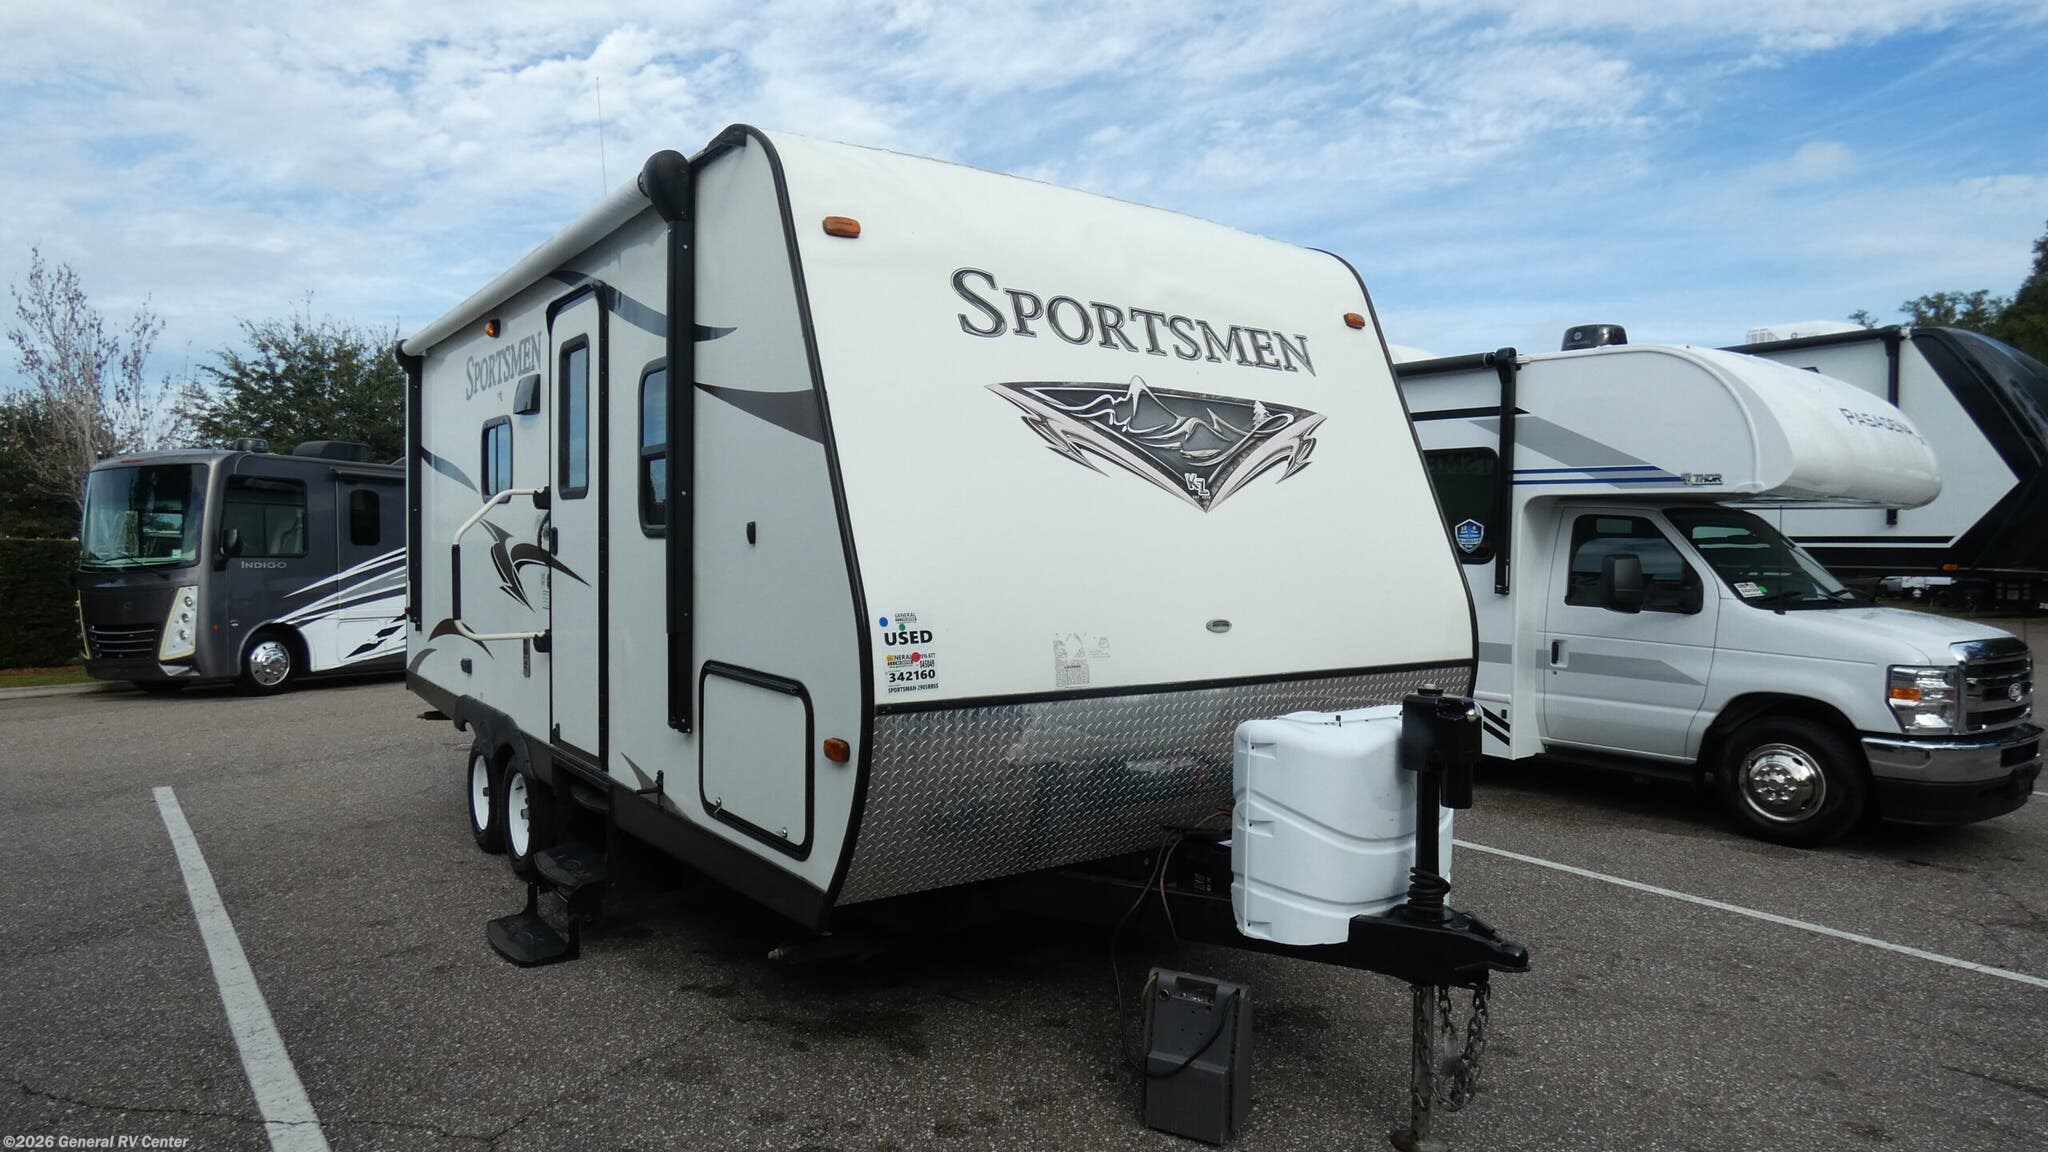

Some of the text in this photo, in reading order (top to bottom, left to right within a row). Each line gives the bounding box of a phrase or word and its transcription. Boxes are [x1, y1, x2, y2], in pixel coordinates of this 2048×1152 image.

[949, 266, 1317, 378] SPORTSMEN
[465, 331, 542, 401] SPORTSMEN
[1692, 473, 1723, 483] THOR
[241, 560, 288, 569] INDIGO
[884, 630, 933, 646] USED
[888, 669, 936, 683] 342160
